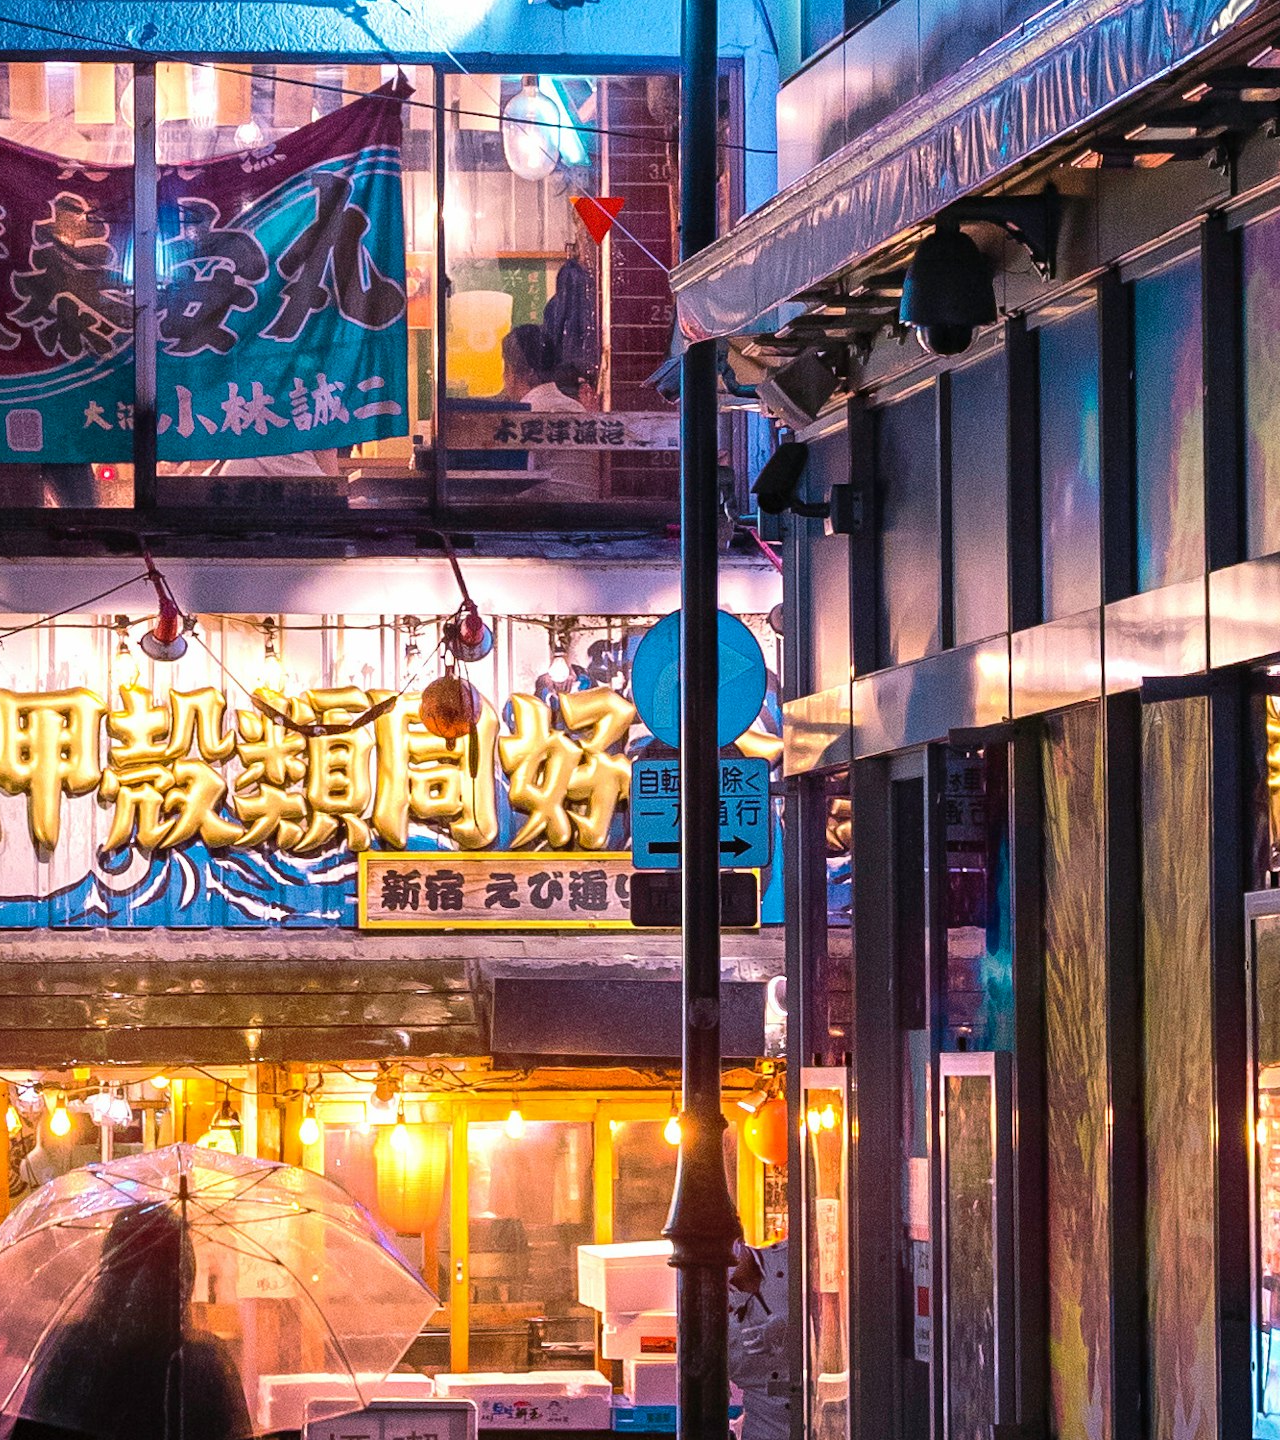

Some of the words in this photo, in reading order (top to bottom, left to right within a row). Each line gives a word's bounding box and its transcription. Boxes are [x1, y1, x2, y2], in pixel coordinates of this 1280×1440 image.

[156, 373, 402, 439] 小林誠二
[638, 766, 761, 794] 自転除く
[381, 869, 466, 911] 新宿
